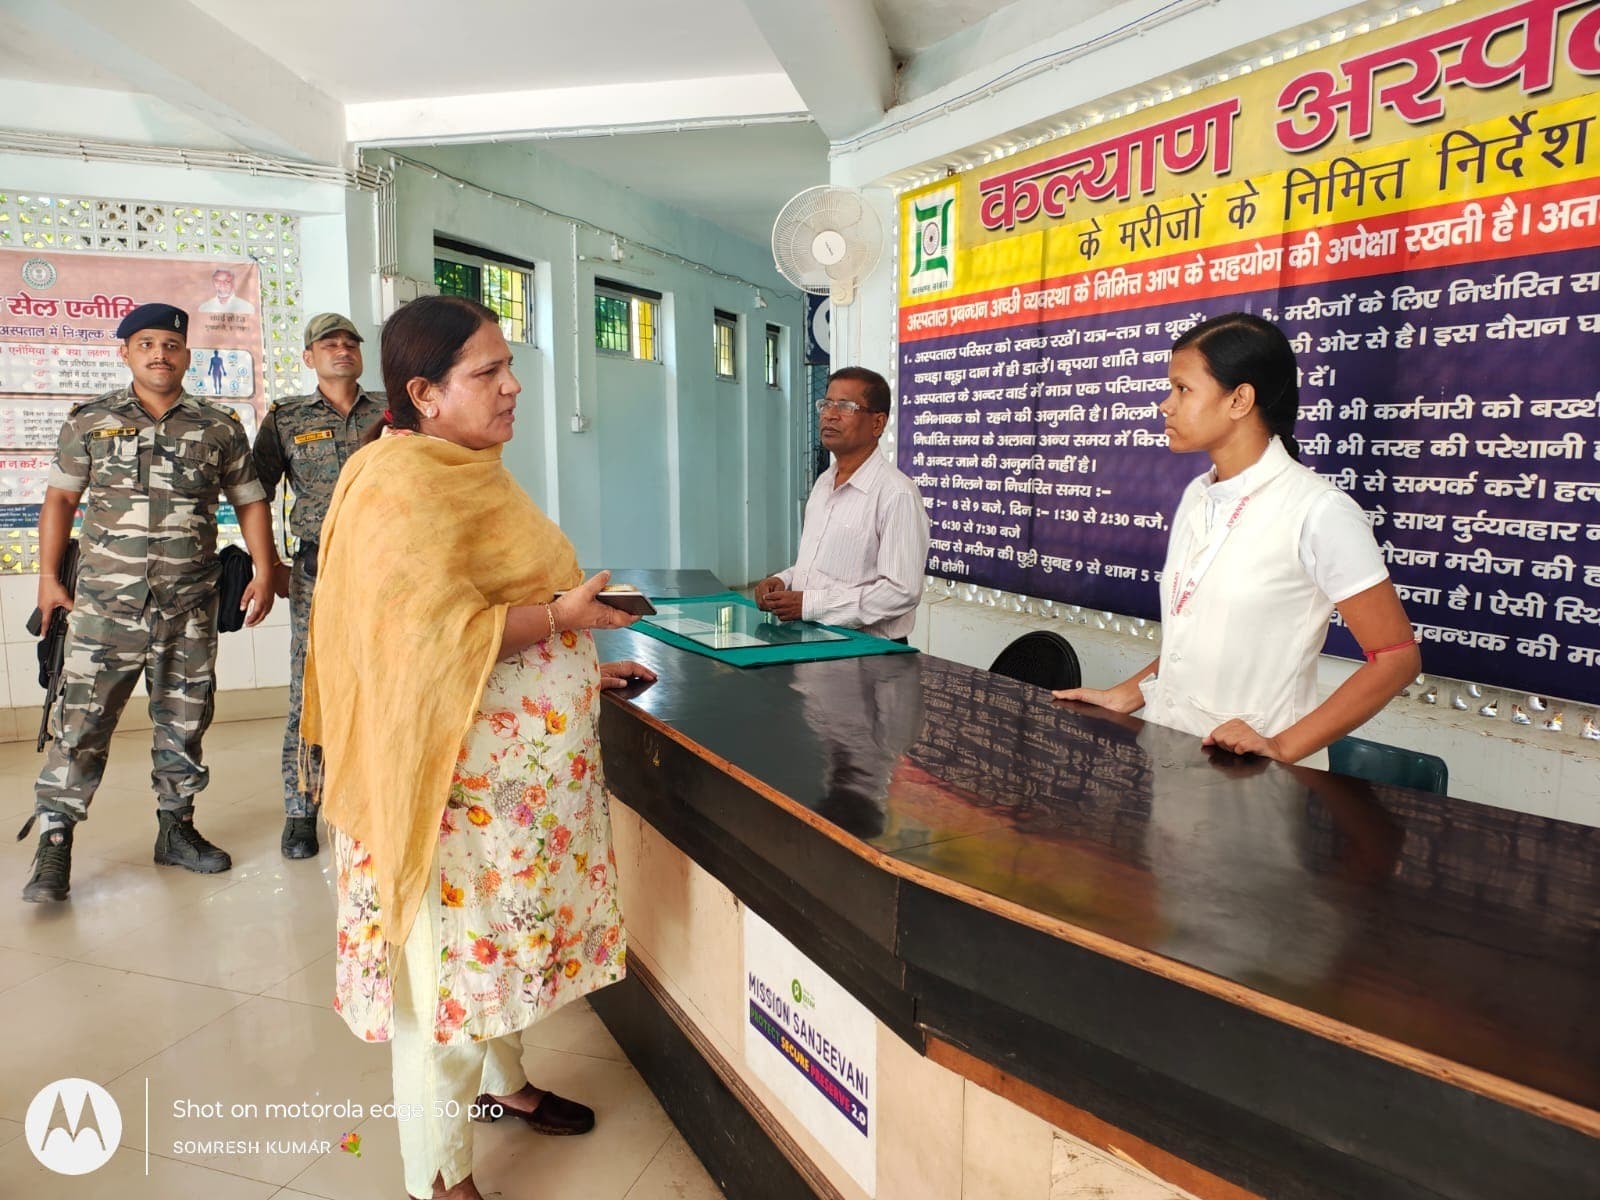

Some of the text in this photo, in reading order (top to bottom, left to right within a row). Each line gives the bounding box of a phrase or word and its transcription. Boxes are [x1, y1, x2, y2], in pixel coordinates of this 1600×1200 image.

[979, 97, 1241, 231] कल्याण
[1078, 110, 1597, 260] के मरीजों के निमित्त निर्देश
[907, 312, 948, 331] अस्पताल
[949, 304, 988, 328] प्रबन्धन
[990, 288, 1021, 315] अच्छी
[1023, 284, 1070, 313] व्यवस्था
[1074, 275, 1091, 300] के
[1092, 265, 1142, 300] निमित्त
[1145, 264, 1180, 291] आप
[1184, 253, 1204, 284] के
[1208, 243, 1284, 282] सहयोग
[1288, 230, 1323, 269] की
[1325, 224, 1398, 265] अपेक्षा
[1405, 201, 1485, 252] रखती
[7, 291, 59, 317] सेल
[1284, 293, 1357, 321] मरीजों
[1358, 290, 1386, 314] के
[1391, 286, 1442, 311] लिए
[1448, 271, 1563, 306] निर्धारित
[0, 326, 45, 337] अस्पताल
[49, 324, 58, 337] में
[914, 348, 957, 364] अस्पताल
[959, 341, 992, 358] परिसर
[994, 337, 1011, 354] को
[1014, 334, 1049, 351] स्वच्छ
[1083, 322, 1141, 343] यत्र-तत्र
[1145, 321, 1160, 336] न
[1316, 330, 1362, 353] ओर
[1365, 326, 1389, 349] से
[1433, 322, 1480, 348] इस
[1486, 312, 1570, 340] दौरान
[8, 345, 45, 357] एनीमिया
[51, 346, 60, 356] के
[66, 348, 82, 357] क्या
[969, 365, 990, 379] दान
[992, 361, 1005, 377] में
[1006, 360, 1020, 376] ही
[1057, 355, 1098, 377] कृपया
[914, 390, 956, 405] अस्पताल
[957, 387, 969, 402] के
[971, 386, 1004, 402] अन्दर
[1005, 382, 1028, 400] वार्ड
[1030, 381, 1044, 398] में
[1045, 383, 1072, 397] मात्र
[1076, 383, 1101, 397] एक
[1338, 393, 1523, 421] भी कर्मचारी को
[913, 411, 963, 426] अभिभावक
[965, 409, 980, 424] को
[986, 408, 1011, 423] रहने
[1014, 406, 1032, 423] की
[1034, 405, 1086, 427] अनुमति
[1111, 401, 1159, 421] मिलने
[913, 430, 1131, 448] निर्धारित समय के अलावा अन्य समय में
[1336, 433, 1364, 456] भी
[1371, 439, 1424, 459] तरह
[1430, 432, 1469, 459] की
[1475, 432, 1586, 460] परेशानी
[20, 457, 37, 469] करें
[912, 452, 924, 467] भी
[925, 455, 954, 468] अन्दर
[955, 453, 978, 468] जाने
[981, 453, 997, 469] की
[1000, 454, 1045, 475] अनुमति
[1048, 456, 1076, 472] नहीं
[940, 475, 950, 488] से
[952, 475, 983, 491] मिलने
[985, 478, 1001, 492] का
[1004, 476, 1052, 496] निर्धारित
[1055, 484, 1092, 498] समय
[1363, 468, 1387, 492] से
[1393, 471, 1479, 496] सम्पर्क
[952, 500, 959, 510] 8
[960, 497, 971, 512] से
[972, 502, 979, 512] 9
[1009, 500, 1033, 517] दिन
[1053, 509, 1080, 523] 1:30
[1083, 507, 1098, 524] से
[1100, 512, 1130, 527] 2:30
[941, 519, 1022, 539] 6:30 से 7:30 बजे
[1393, 512, 1446, 532] साथ
[1452, 510, 1580, 543] दुर्व्यवहार
[928, 555, 940, 570] ही
[952, 539, 963, 552] से
[964, 541, 995, 558] मरीज
[997, 545, 1015, 561] की
[1041, 553, 1072, 574] सुबह
[1075, 560, 1083, 572] 9
[1086, 558, 1101, 576] से
[1104, 564, 1137, 581] शाम
[1140, 569, 1150, 582] 5
[1445, 548, 1524, 577] मरीज
[1531, 554, 1577, 582] की
[1489, 589, 1548, 619] ऐसी
[1517, 633, 1560, 661] की
[749, 971, 869, 1099] MISSION SANJEEVANI
[750, 1006, 866, 1127] PROTECT SECURE PRESERVE 2.0
